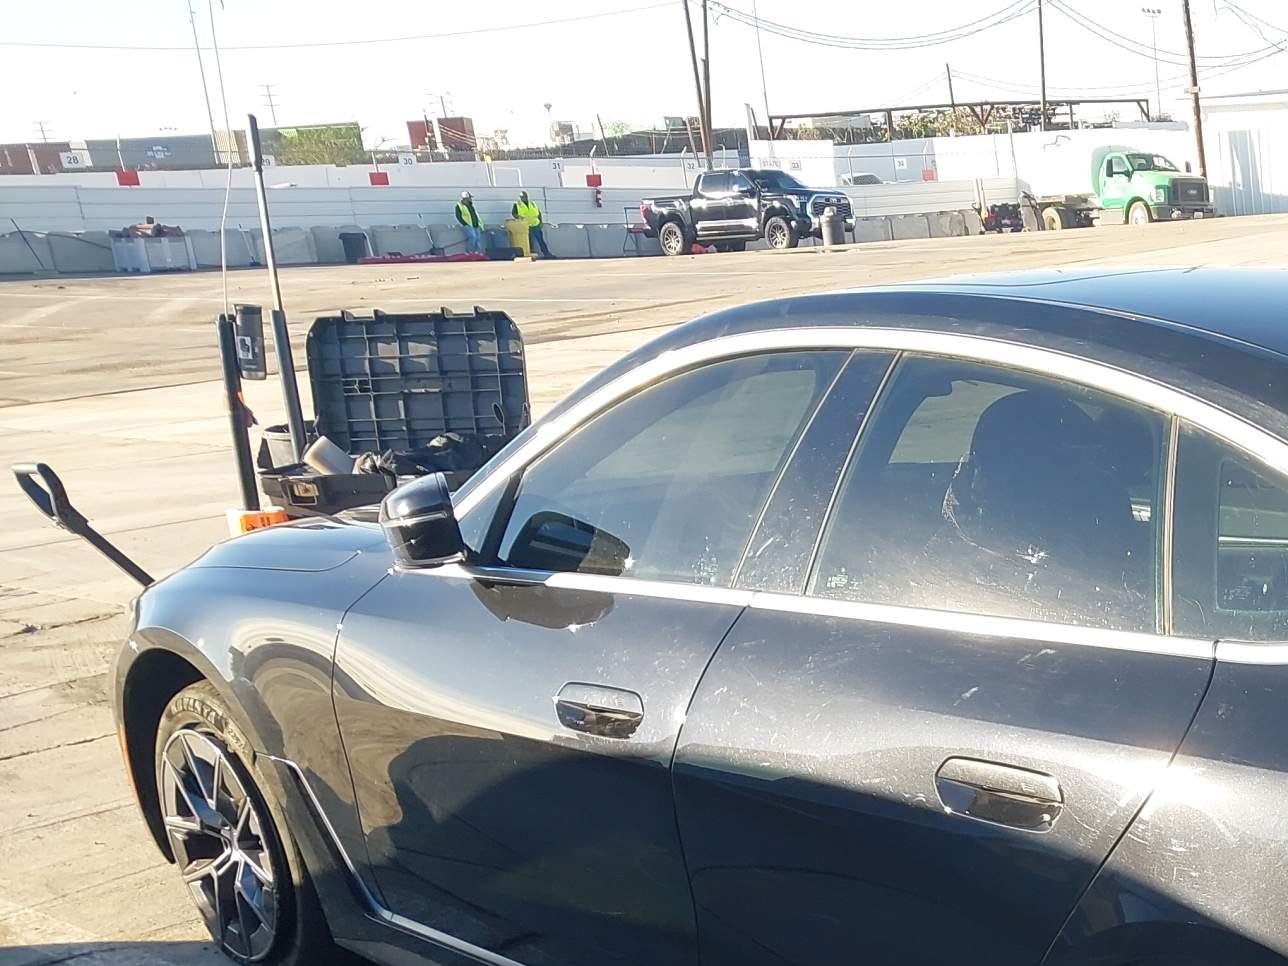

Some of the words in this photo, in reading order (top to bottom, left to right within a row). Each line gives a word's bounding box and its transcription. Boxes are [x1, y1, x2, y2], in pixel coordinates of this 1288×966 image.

[66, 155, 79, 165] 28
[402, 157, 413, 166] 30
[552, 162, 561, 171] 31
[687, 162, 695, 170] 32
